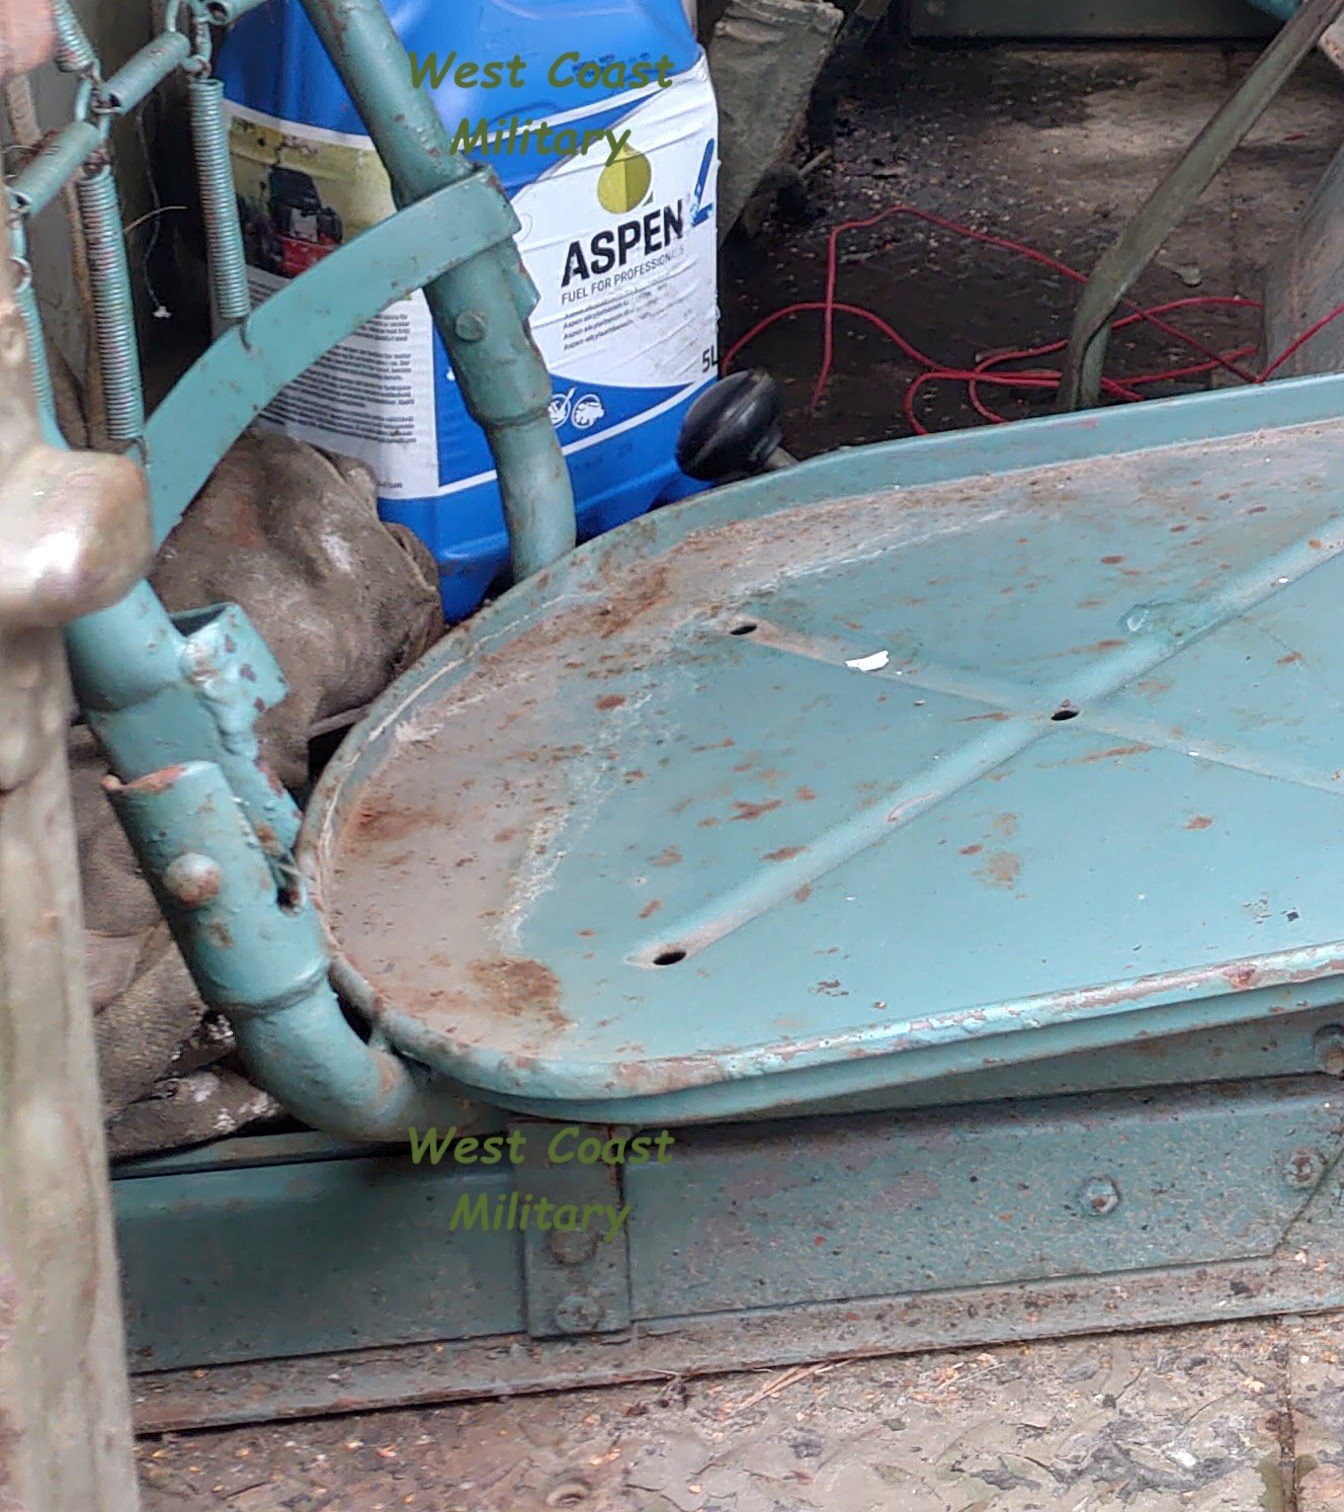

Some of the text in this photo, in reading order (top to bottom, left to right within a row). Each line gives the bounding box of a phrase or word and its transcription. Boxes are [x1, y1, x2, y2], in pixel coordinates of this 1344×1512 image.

[561, 199, 683, 287] ASPEN
[561, 288, 588, 305] FUEL
[591, 277, 612, 294] FOR
